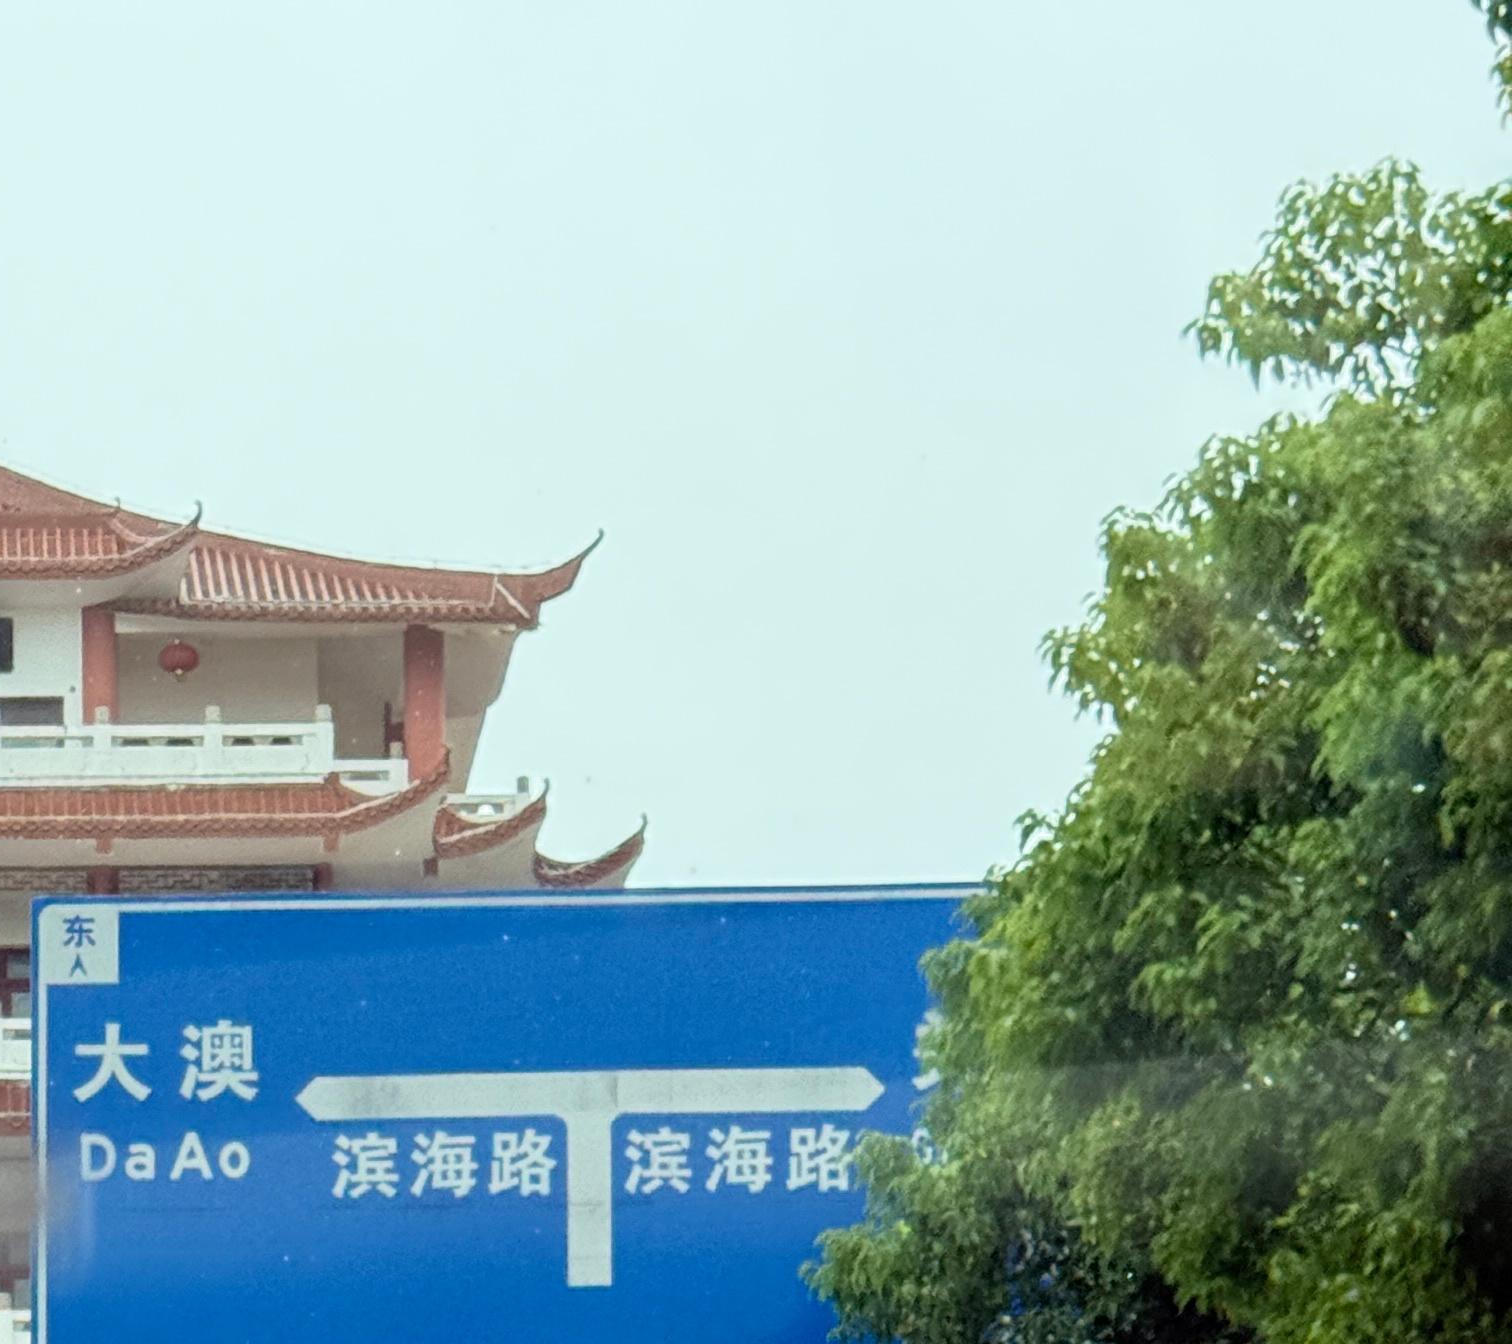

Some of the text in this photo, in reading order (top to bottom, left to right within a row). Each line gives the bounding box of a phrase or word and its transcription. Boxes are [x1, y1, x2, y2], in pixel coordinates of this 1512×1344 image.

[62, 915, 96, 949] 东
[73, 1019, 259, 1102] 大澳
[331, 1128, 557, 1198] 滨海路
[624, 1124, 855, 1194] 滨海路
